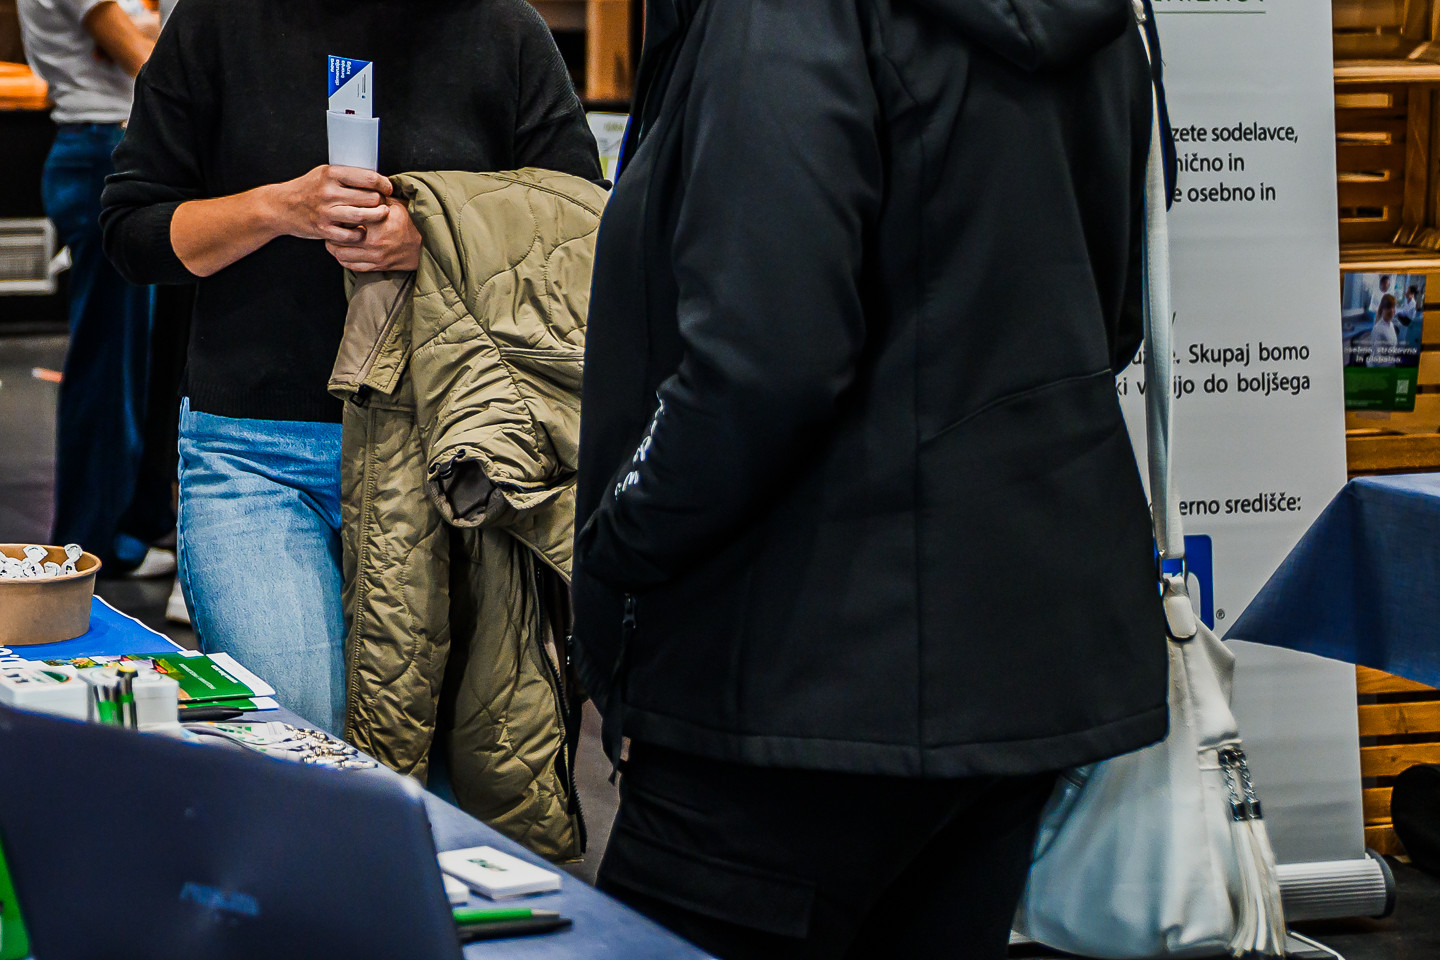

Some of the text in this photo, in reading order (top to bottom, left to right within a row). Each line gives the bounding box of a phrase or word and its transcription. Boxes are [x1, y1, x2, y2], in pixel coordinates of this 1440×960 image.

[1211, 121, 1299, 144] sodelavce,
[1228, 152, 1245, 172] in
[1187, 181, 1256, 203] osebno
[1260, 181, 1276, 201] in
[1188, 343, 1251, 367] Skupaj
[1259, 342, 1310, 362] bomo
[1203, 373, 1229, 394] do
[1237, 372, 1311, 397] boljšega
[1224, 491, 1302, 515] središče:
